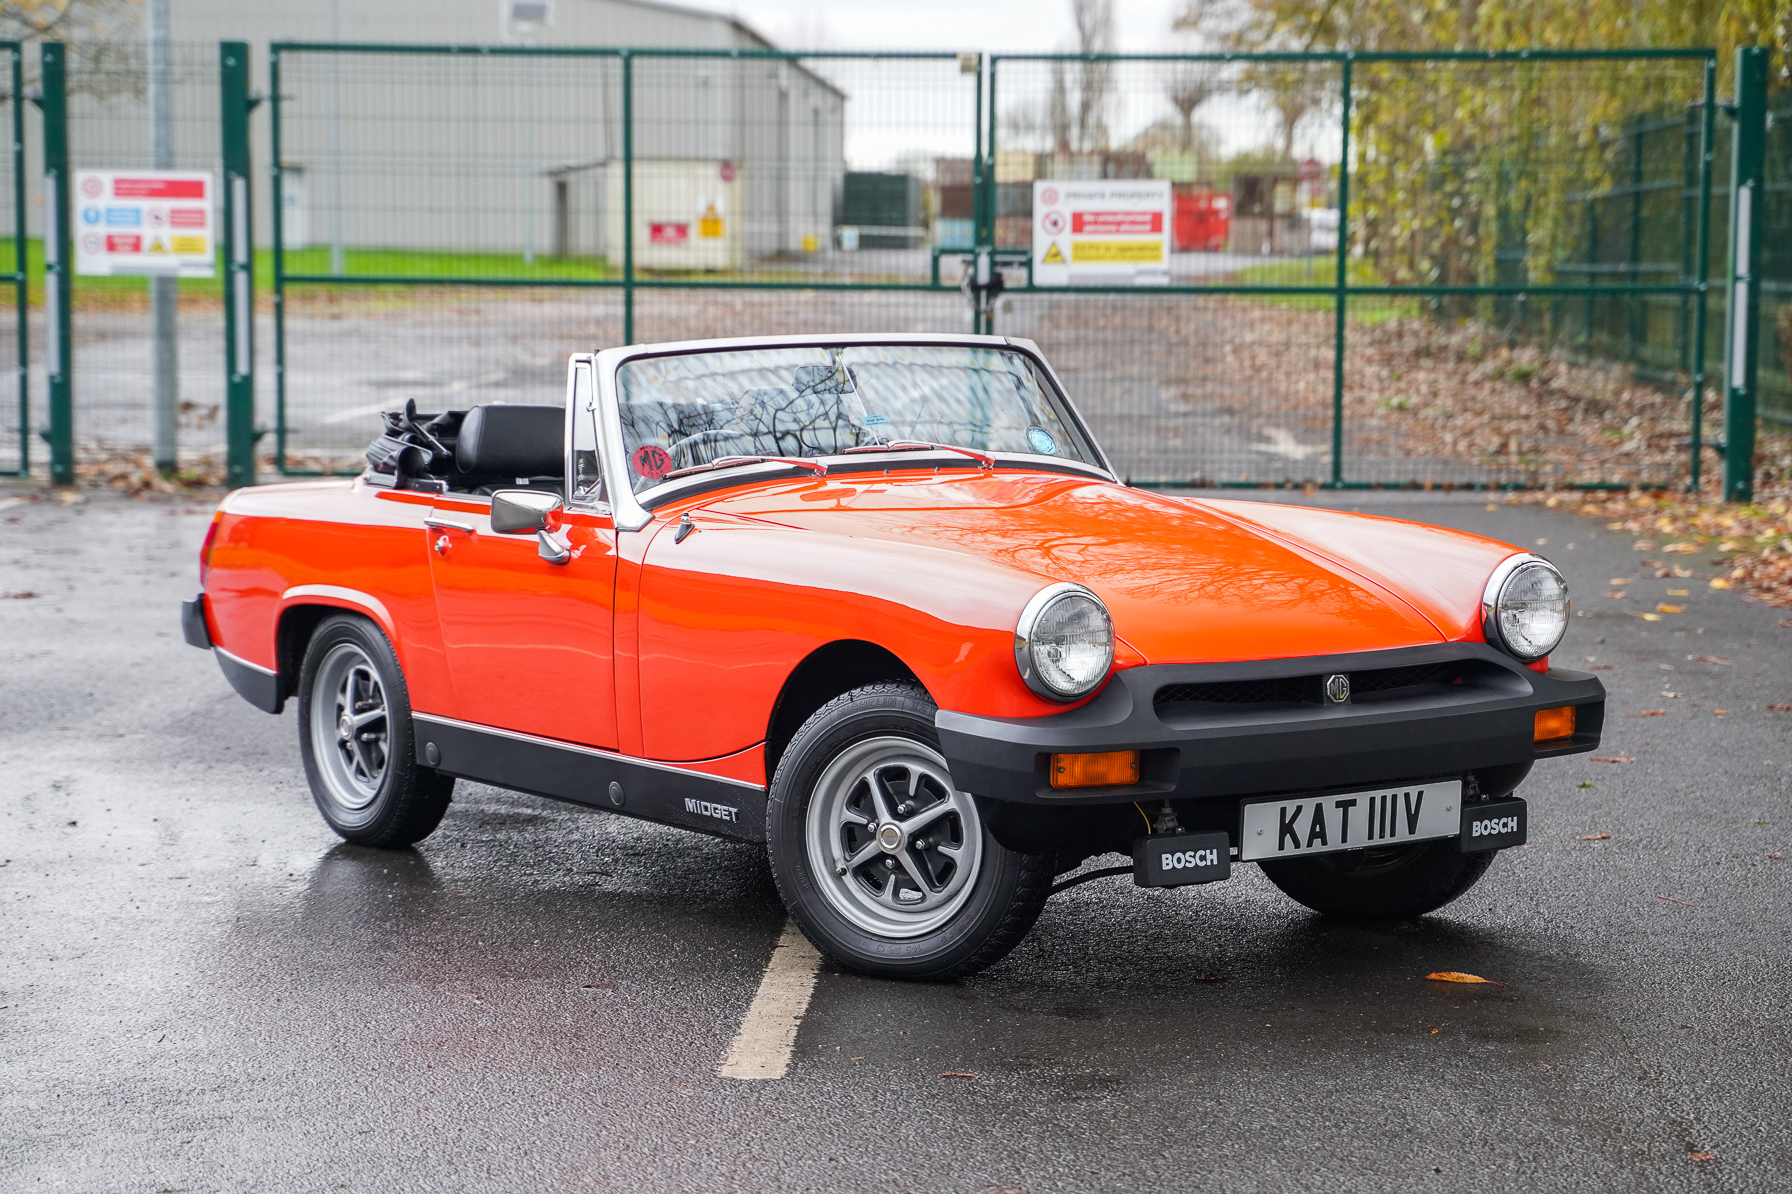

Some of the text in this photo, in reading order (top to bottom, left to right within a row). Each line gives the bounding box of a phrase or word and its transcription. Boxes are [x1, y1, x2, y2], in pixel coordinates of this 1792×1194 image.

[1064, 191, 1164, 200] PRIVATE PROPERTY
[639, 449, 665, 471] MG
[1331, 678, 1347, 699] MG
[837, 696, 897, 719] MICHELIN
[684, 797, 739, 823] MIDGET
[1278, 798, 1358, 851] KAT
[1472, 816, 1518, 837] BOSCH
[1161, 848, 1218, 870] BOSCH
